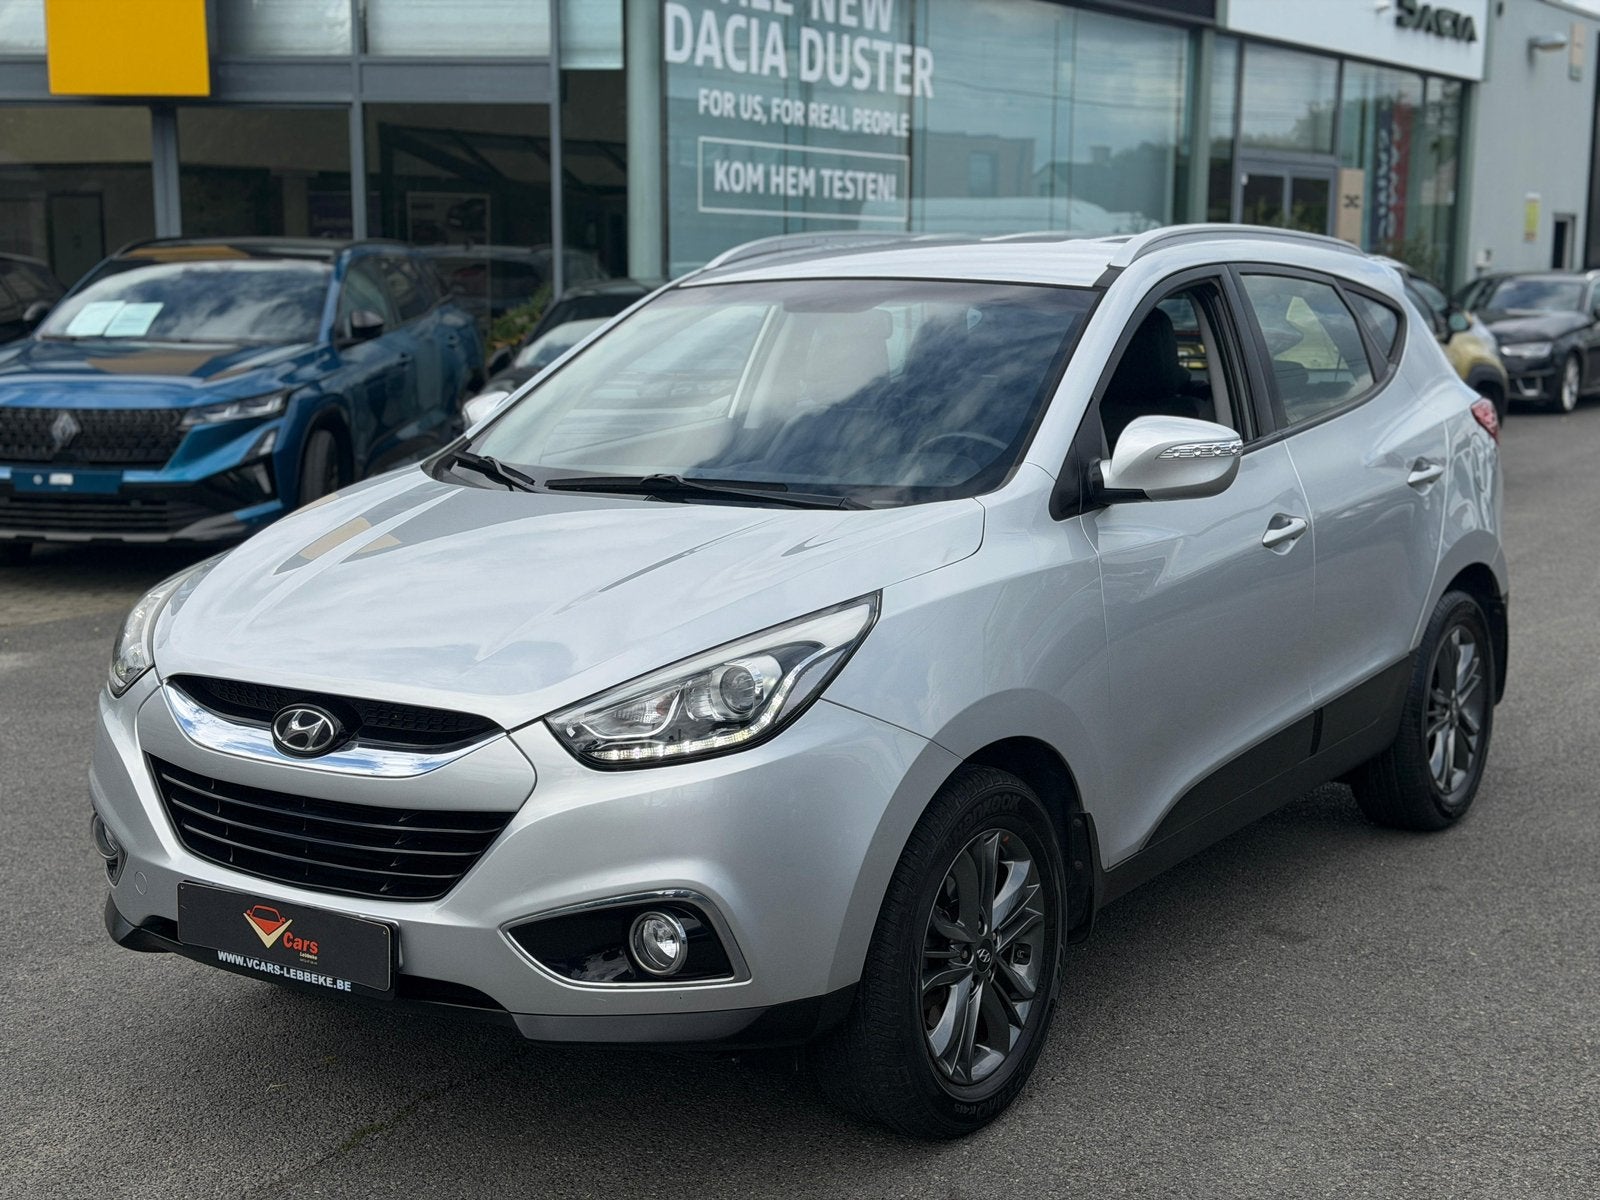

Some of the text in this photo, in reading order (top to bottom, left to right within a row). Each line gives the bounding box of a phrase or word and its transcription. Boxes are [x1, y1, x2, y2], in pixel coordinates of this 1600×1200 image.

[664, 2, 934, 98] DACIA DUSTER
[698, 88, 910, 137] FOR US, FOR REAL PEOPLE
[714, 159, 897, 201] KOM HEM TESTEN!
[282, 931, 319, 955] Cars
[217, 950, 352, 992] WWW.VCARS-LEBBEKE.BE
